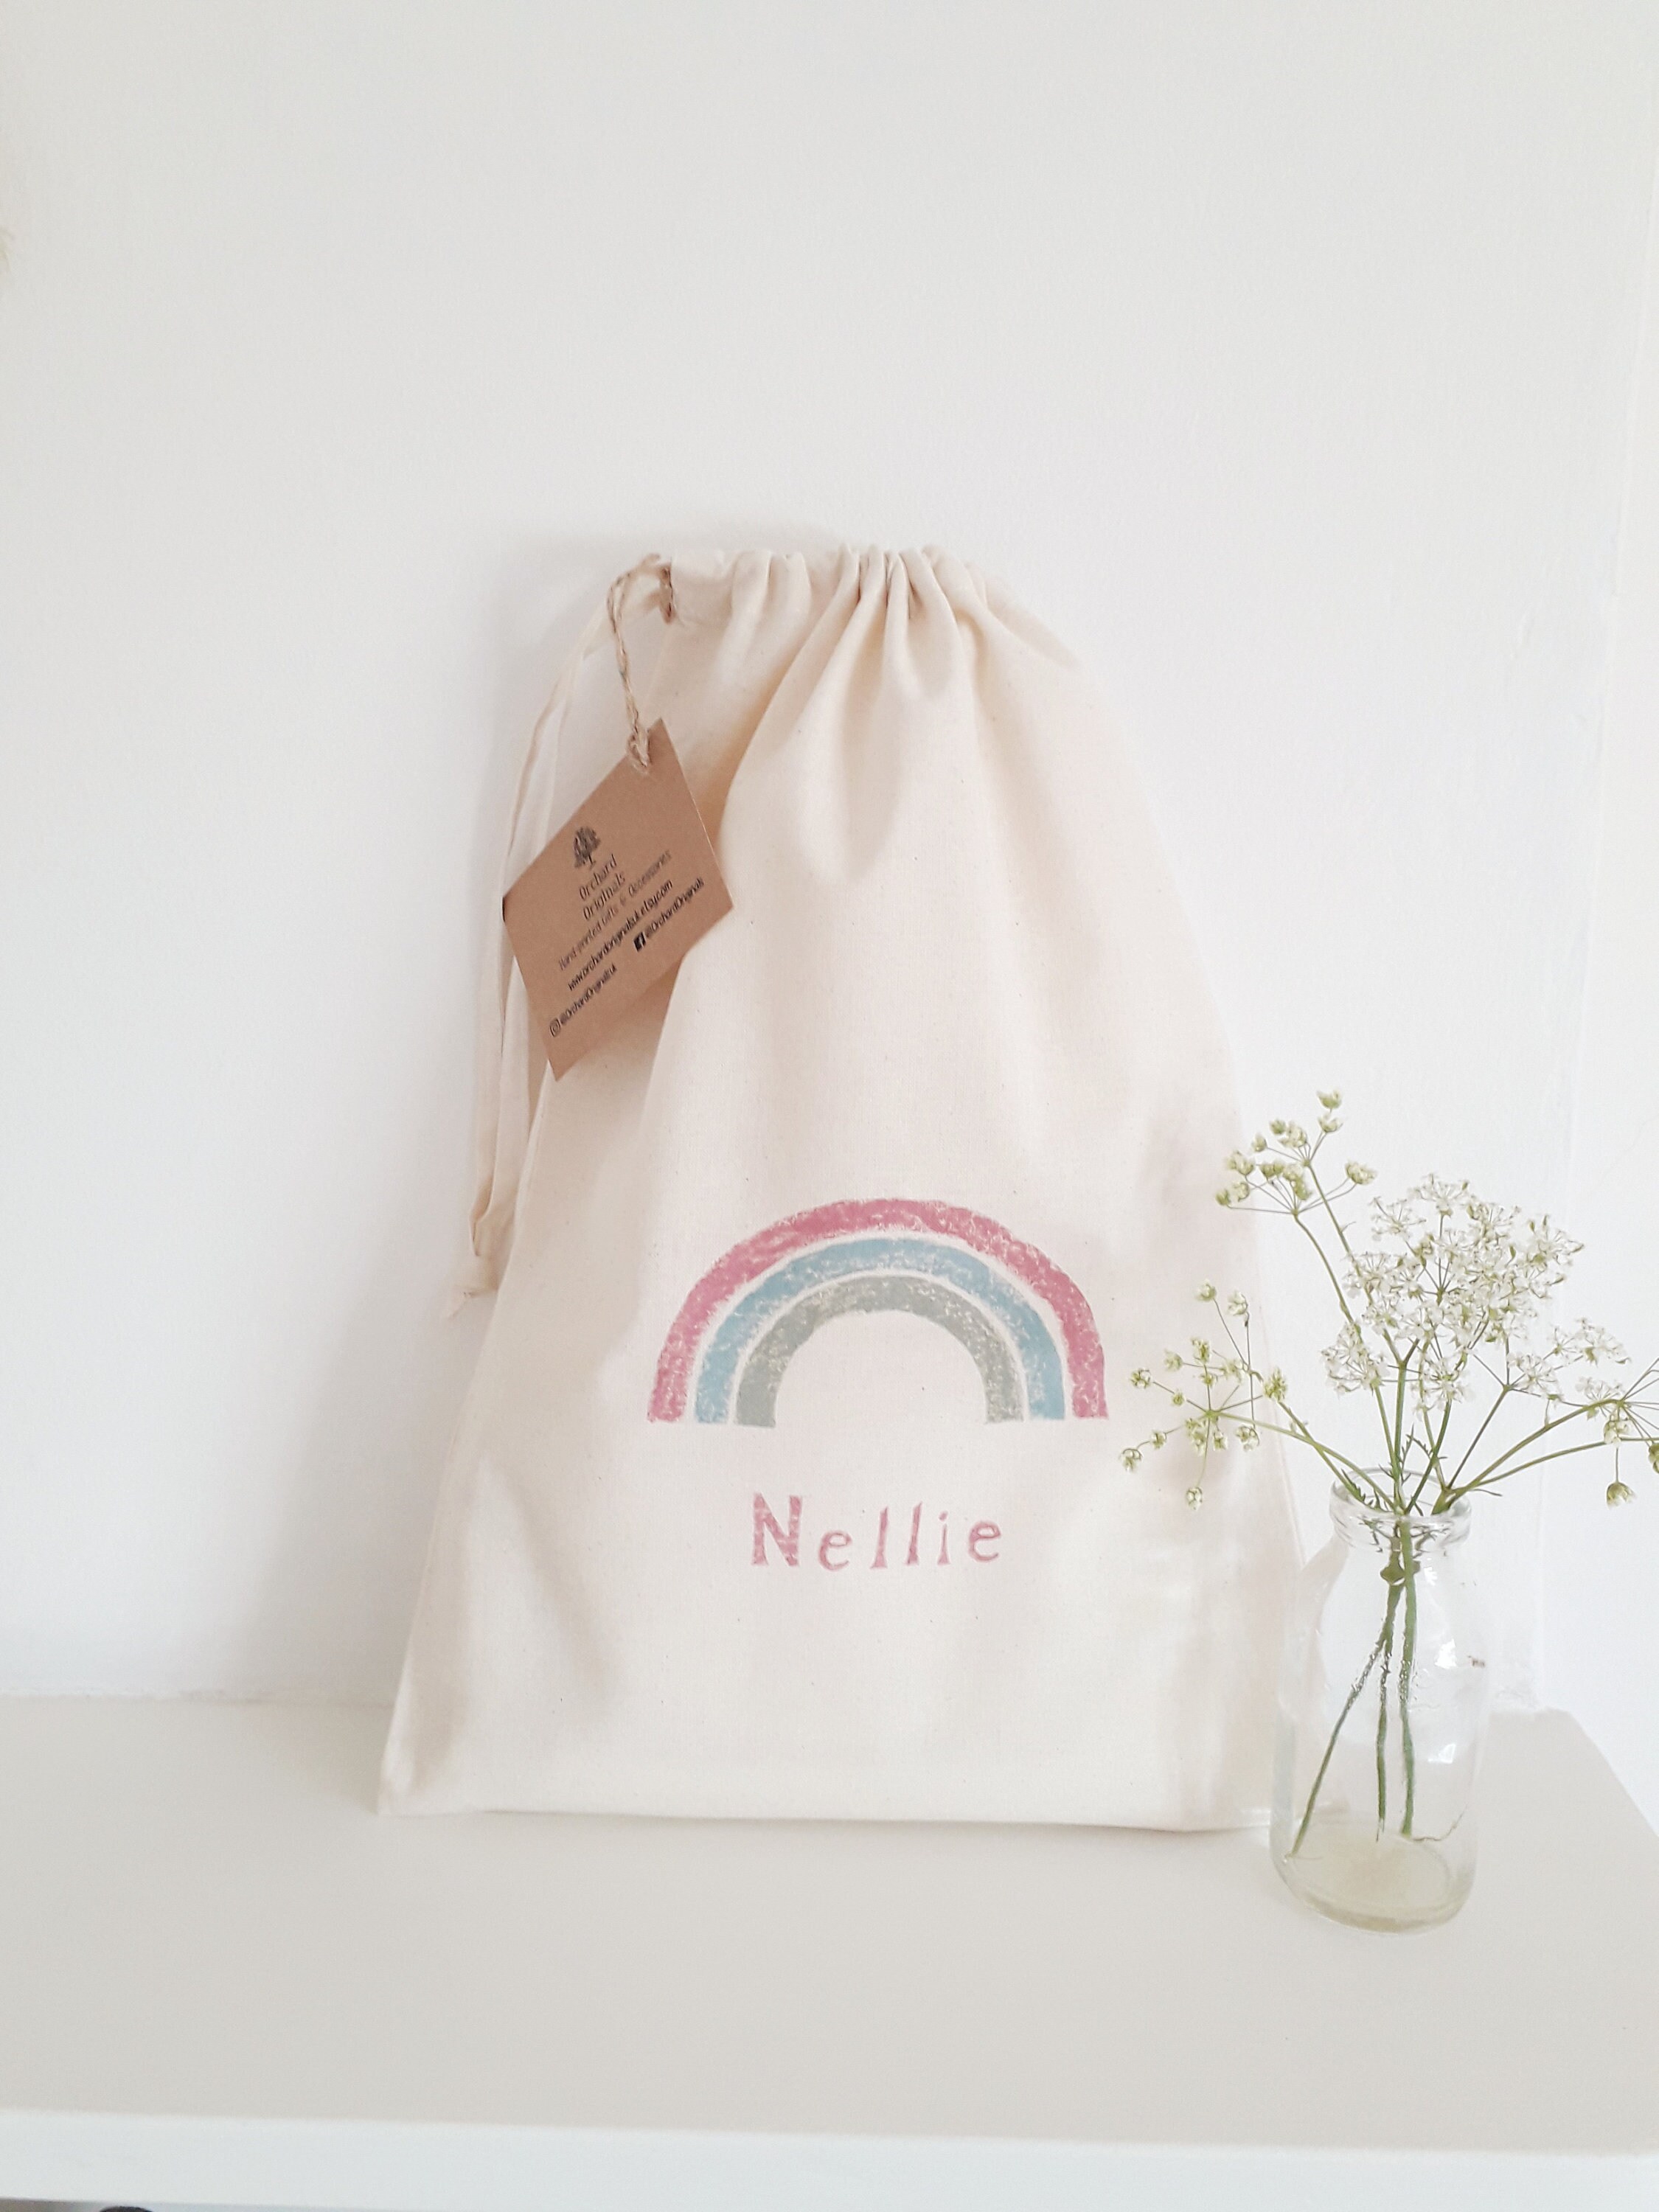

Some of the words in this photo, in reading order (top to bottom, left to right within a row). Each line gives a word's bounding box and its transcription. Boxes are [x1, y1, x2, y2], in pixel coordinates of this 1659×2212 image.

[579, 853, 617, 901] Orchard
[582, 871, 626, 920] Originals
[751, 1492, 1002, 1571] Nellie
